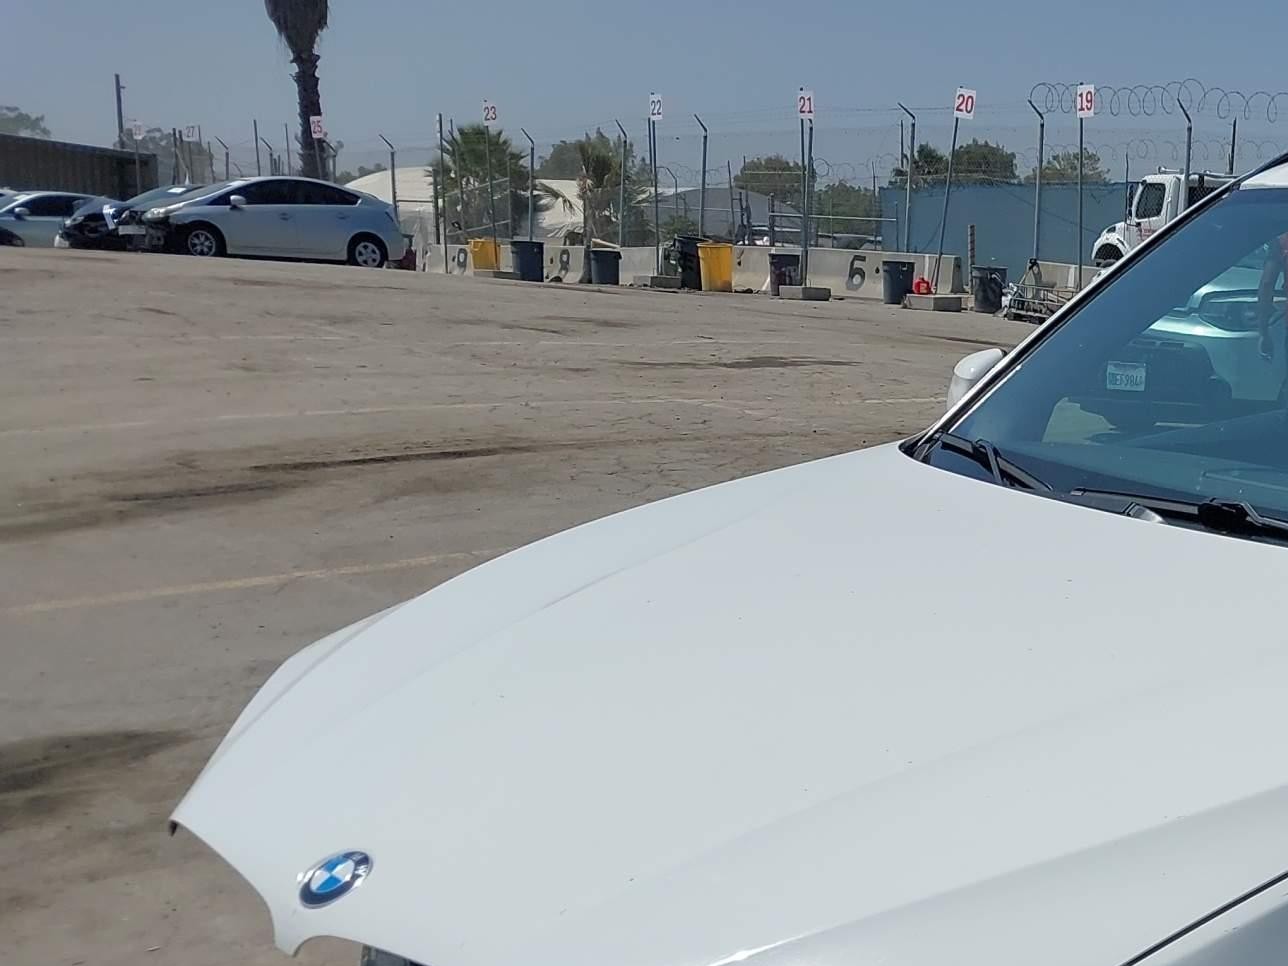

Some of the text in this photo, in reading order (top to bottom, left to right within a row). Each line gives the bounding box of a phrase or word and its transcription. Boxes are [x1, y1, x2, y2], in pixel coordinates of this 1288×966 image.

[651, 100, 662, 116] 22
[799, 96, 813, 114] 21
[956, 94, 974, 114] 20
[1078, 91, 1093, 112] 19
[483, 106, 497, 121] 23
[312, 120, 323, 135] 25
